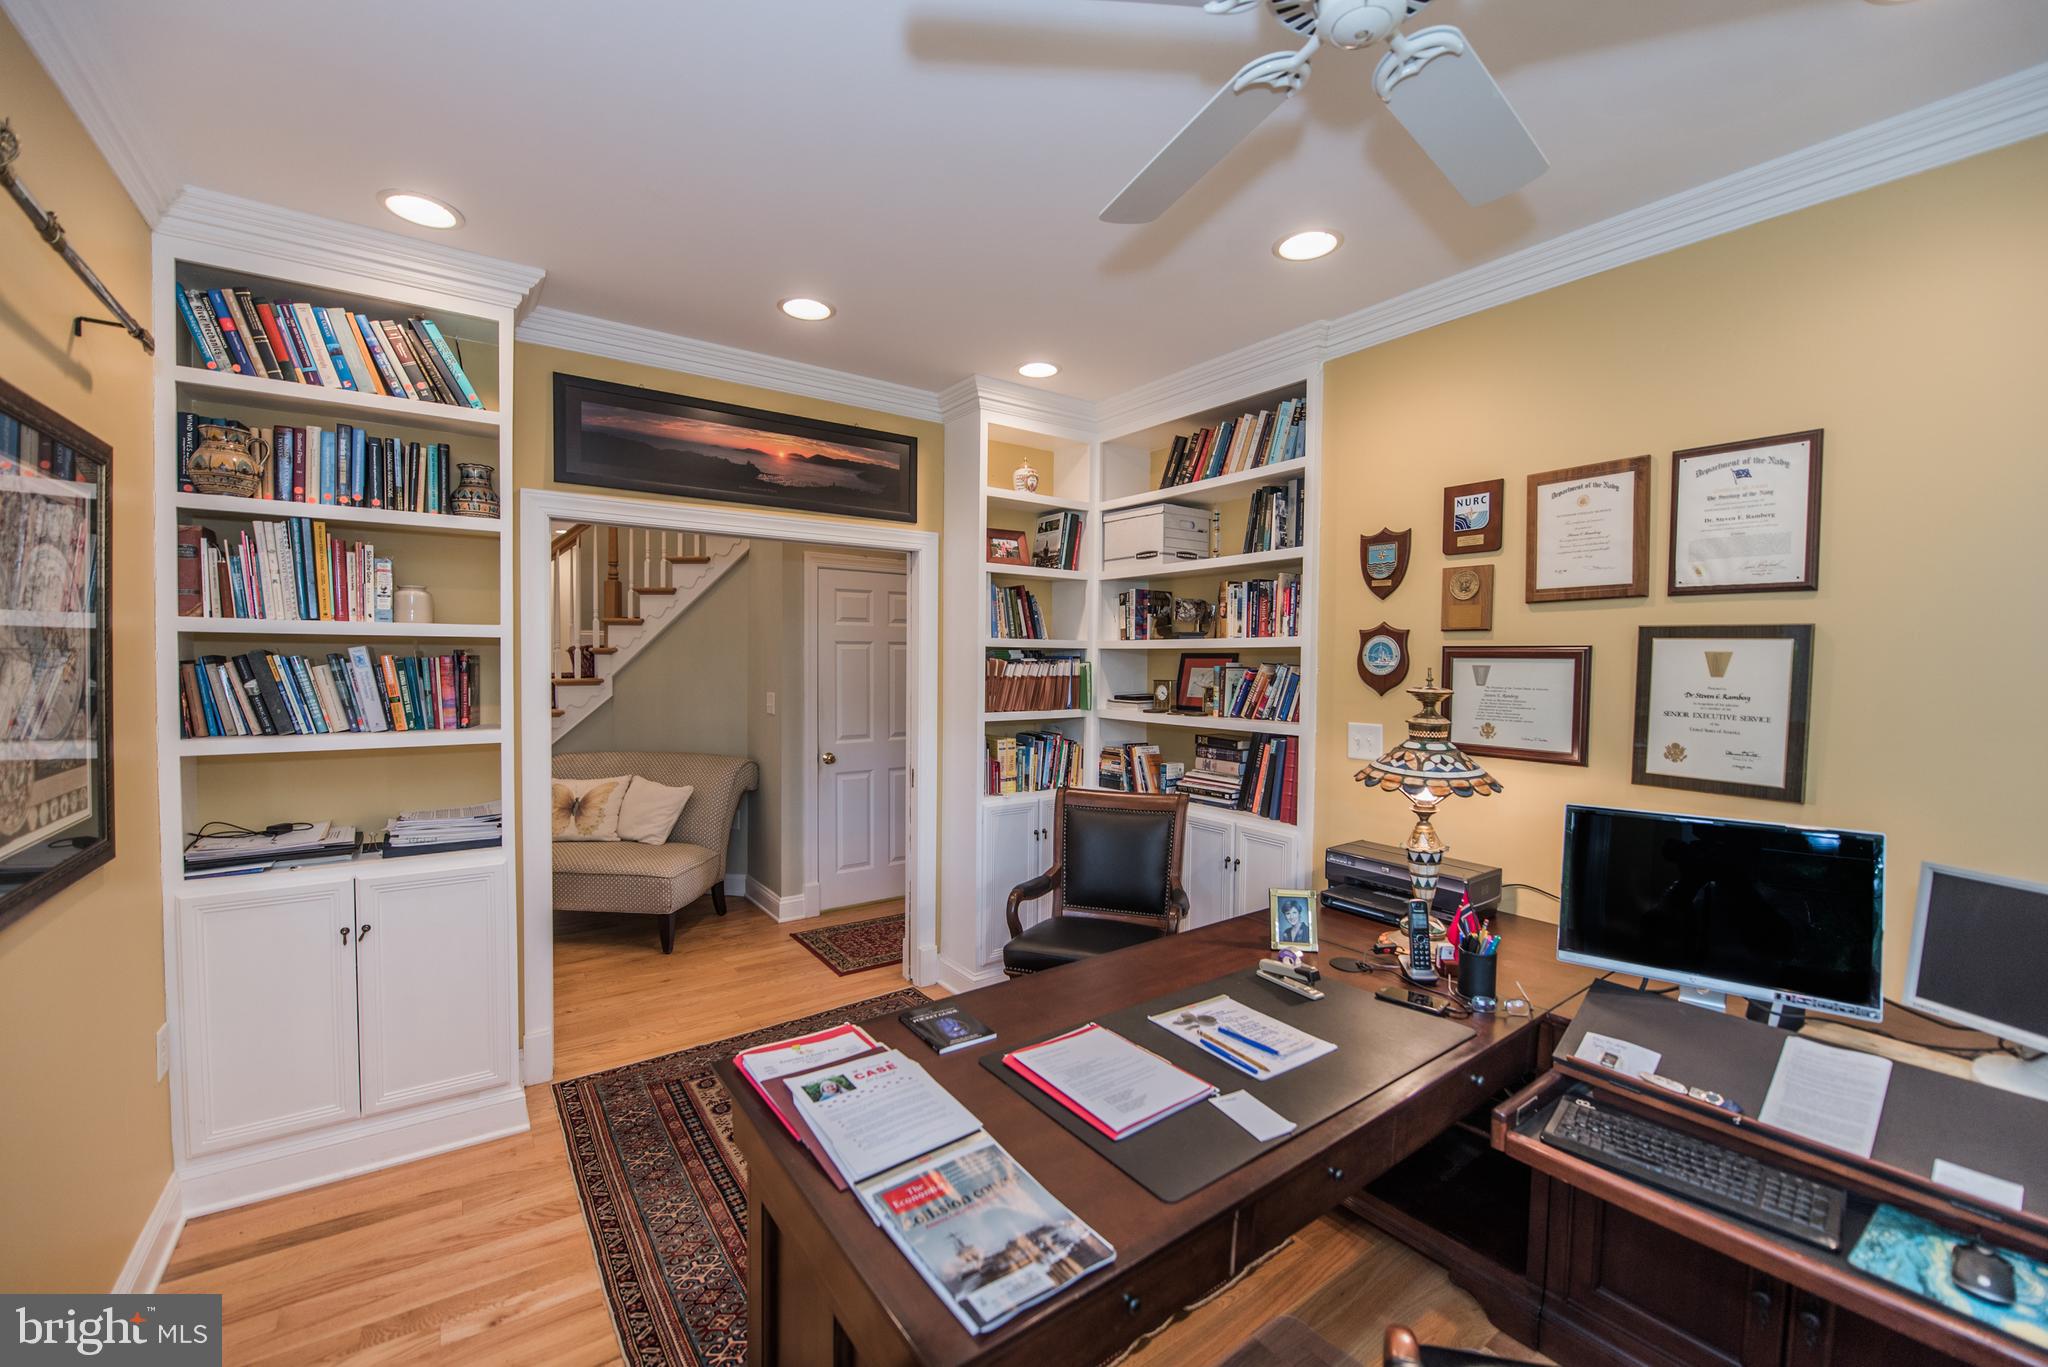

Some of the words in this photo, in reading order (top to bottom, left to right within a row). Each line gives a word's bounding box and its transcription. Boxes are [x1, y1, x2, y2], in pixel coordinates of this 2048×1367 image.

[203, 323, 222, 357] Mechanics
[1696, 458, 1740, 478] Department
[1742, 456, 1751, 464] of
[1753, 456, 1766, 464] the
[1767, 456, 1790, 469] Navy
[1551, 483, 1584, 500] Department
[1603, 481, 1620, 492] Navy
[1456, 495, 1487, 507] NURC
[1746, 512, 1776, 520] Ramberg
[1695, 692, 1714, 700] Steven
[1722, 694, 1751, 703] Ramberg
[1664, 710, 1690, 718] SENIOR
[1692, 712, 1736, 721] EXECUTIVE
[1739, 715, 1772, 724] SERVICE
[854, 1062, 897, 1080] CASE
[905, 1182, 924, 1196] The
